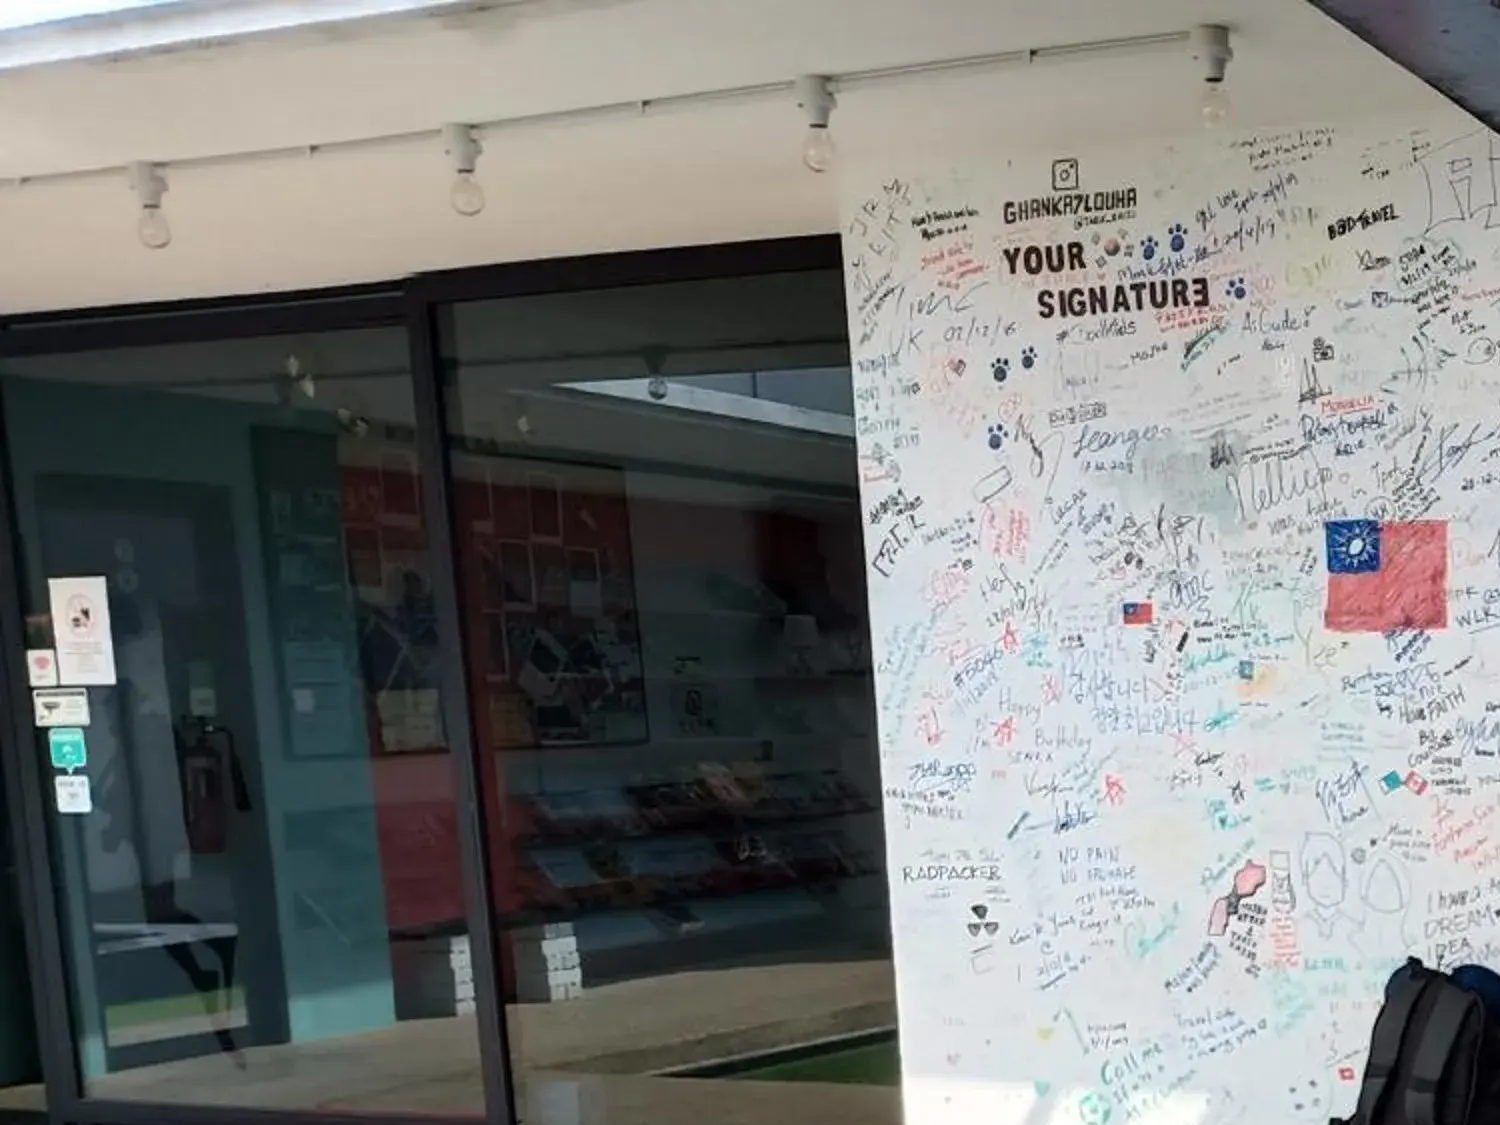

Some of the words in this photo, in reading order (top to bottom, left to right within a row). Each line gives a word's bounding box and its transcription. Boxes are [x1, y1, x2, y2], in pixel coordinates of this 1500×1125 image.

[1003, 187, 1137, 225] GHANKA7LOUHA
[1003, 241, 1087, 276] YOUR
[1038, 277, 1210, 319] SIGNATURE
